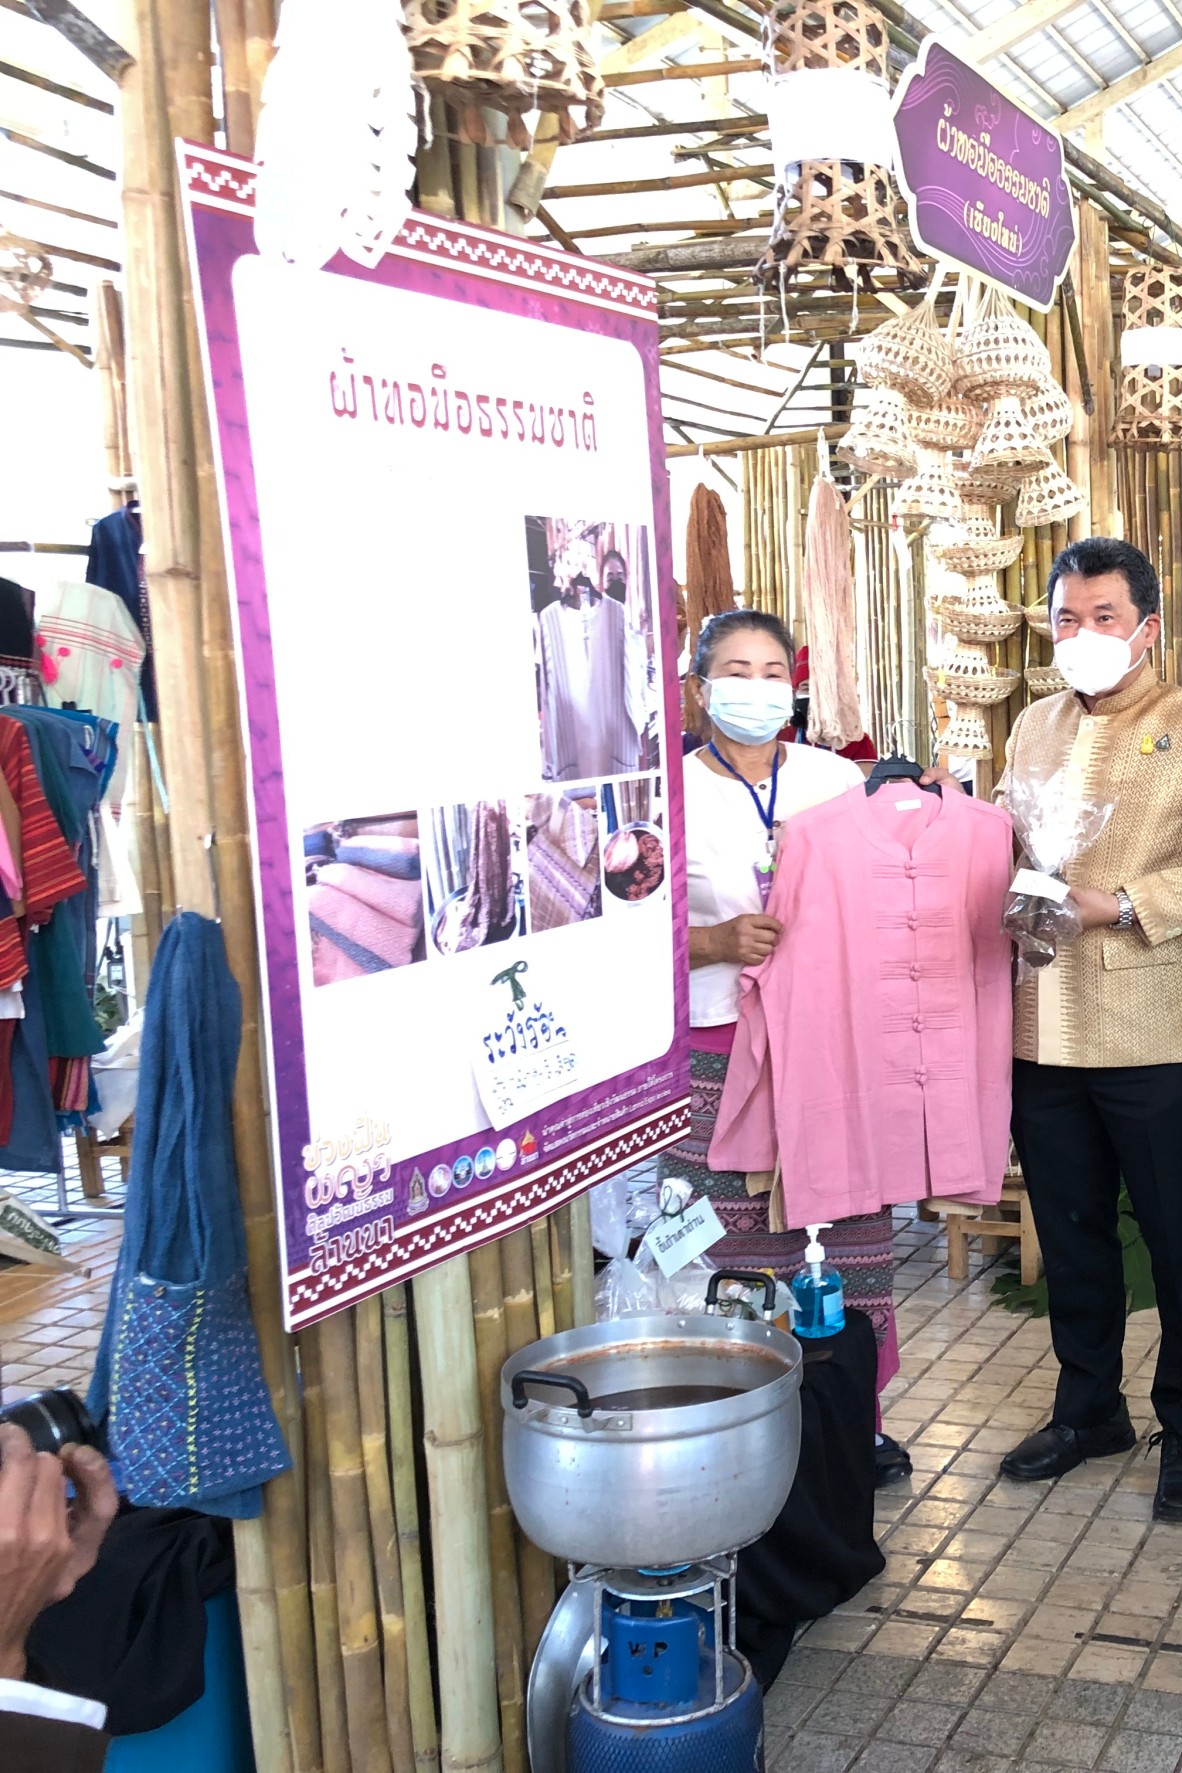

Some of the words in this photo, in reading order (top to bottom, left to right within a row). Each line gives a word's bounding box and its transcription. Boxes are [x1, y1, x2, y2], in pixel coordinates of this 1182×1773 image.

[936, 103, 1051, 219] ผ้าทอมือธรรมชาติ
[963, 200, 1023, 257] (เชียงใหม่)
[329, 346, 598, 452] ผ้าทอมือธรรมชาติ
[308, 1214, 395, 1277] ล้านนา
